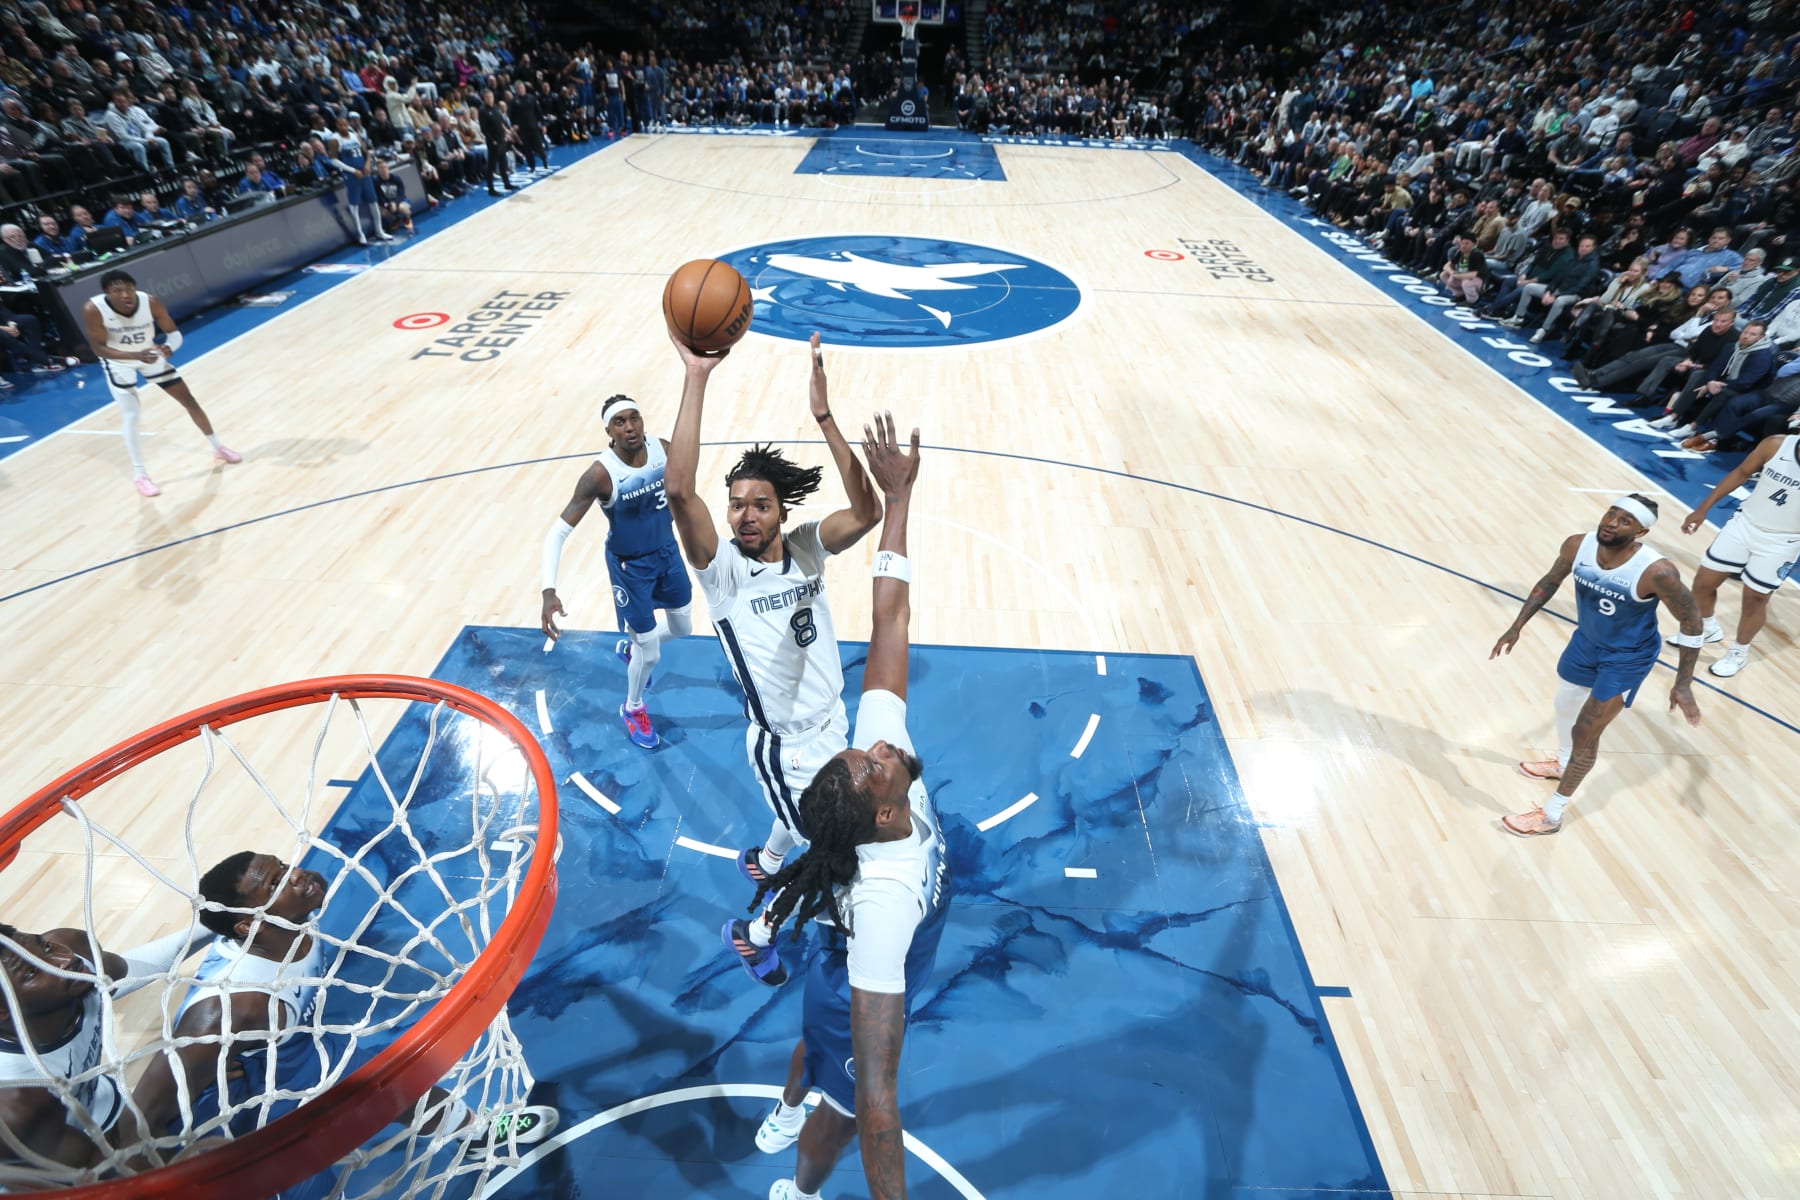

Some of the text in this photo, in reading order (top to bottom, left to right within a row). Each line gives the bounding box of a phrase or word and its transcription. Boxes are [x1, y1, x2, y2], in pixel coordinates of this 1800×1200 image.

[889, 115, 926, 124] CFMOTO
[223, 238, 282, 270] dayforce
[1177, 237, 1240, 280] TARGET
[1207, 239, 1275, 283] CENTER
[119, 332, 146, 345] 45
[409, 290, 529, 361] TARGET
[459, 290, 571, 362] CENTER
[1480, 336, 1553, 368] OF
[621, 478, 665, 502] MINNESOT
[1765, 467, 1800, 490] MEMP
[654, 489, 668, 510] 3
[1768, 488, 1788, 507] 4
[1574, 573, 1626, 602] MINNESOTA
[1598, 598, 1616, 616] 9
[790, 607, 818, 648] 8
